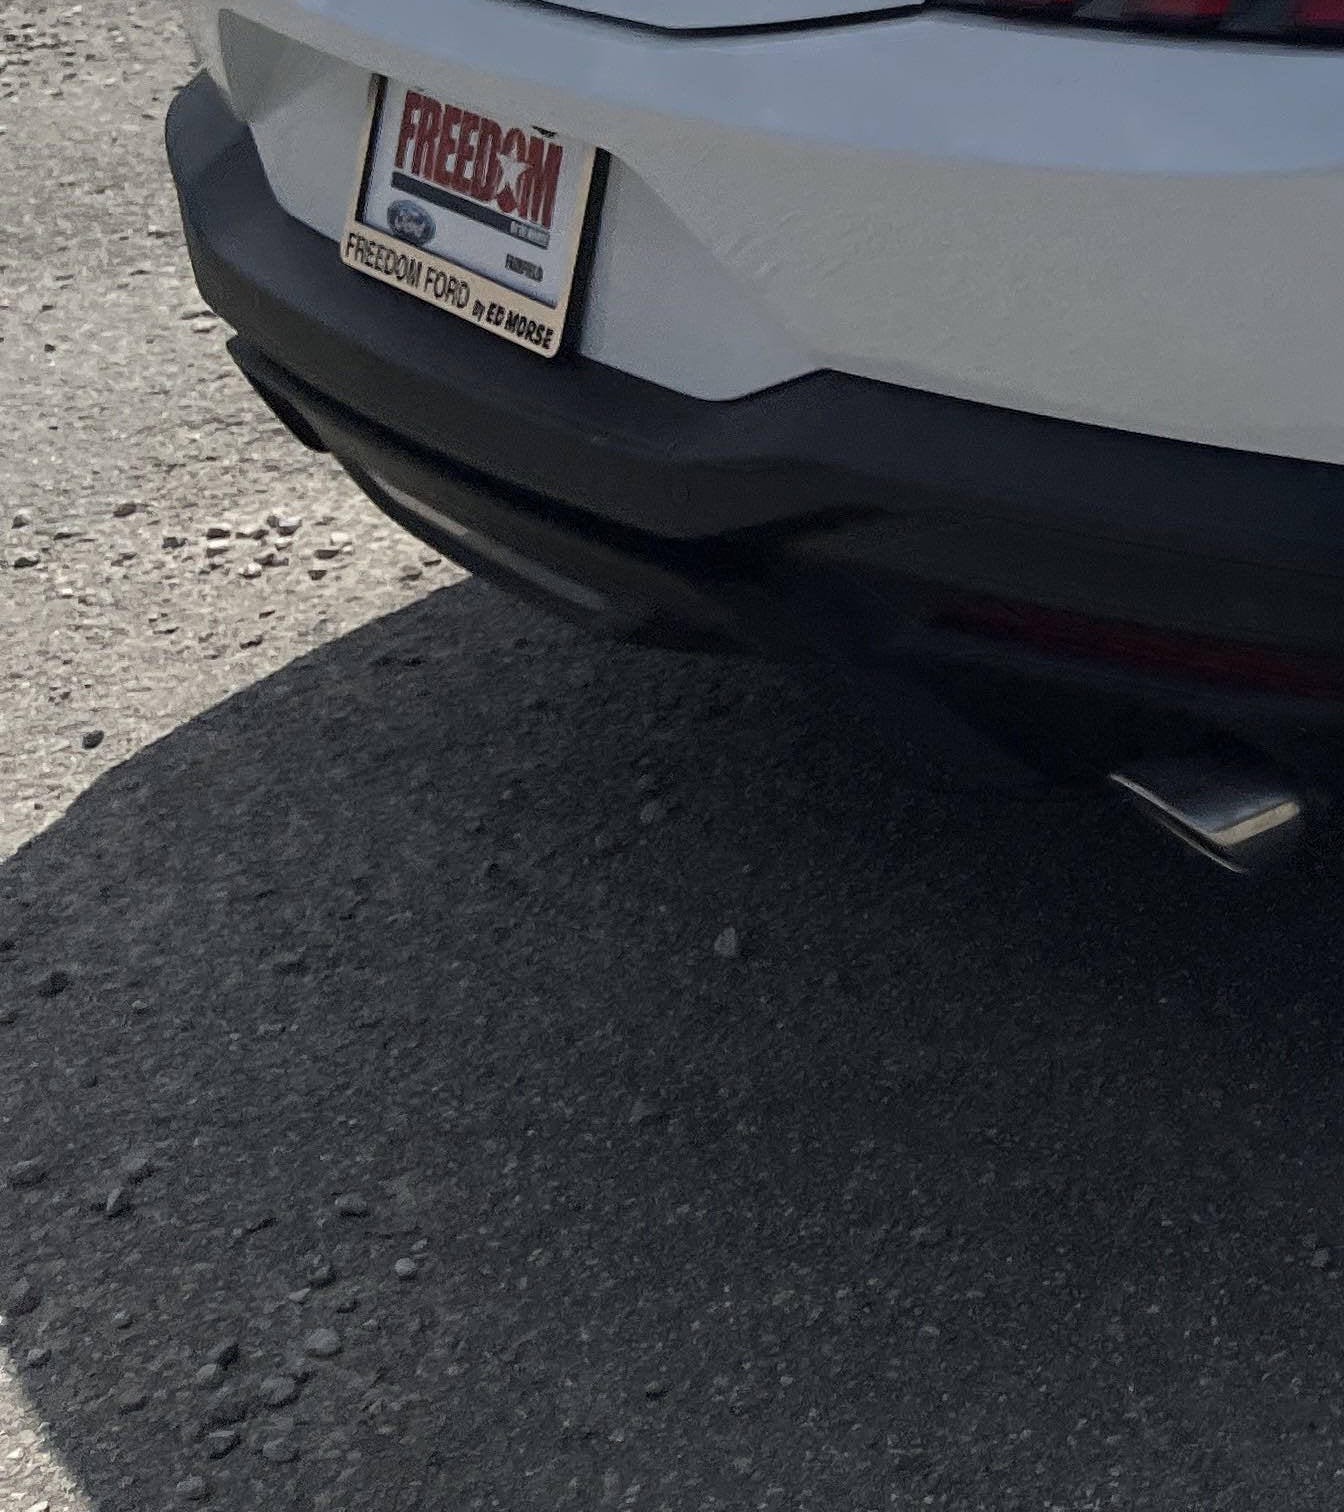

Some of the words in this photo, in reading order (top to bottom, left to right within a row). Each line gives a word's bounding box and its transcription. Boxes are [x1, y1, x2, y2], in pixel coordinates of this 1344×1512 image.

[394, 89, 564, 229] FREEDOM
[344, 232, 423, 290] FREEDOM
[424, 265, 471, 310] FORD
[486, 302, 505, 326] ED
[504, 310, 554, 350] MORSE
